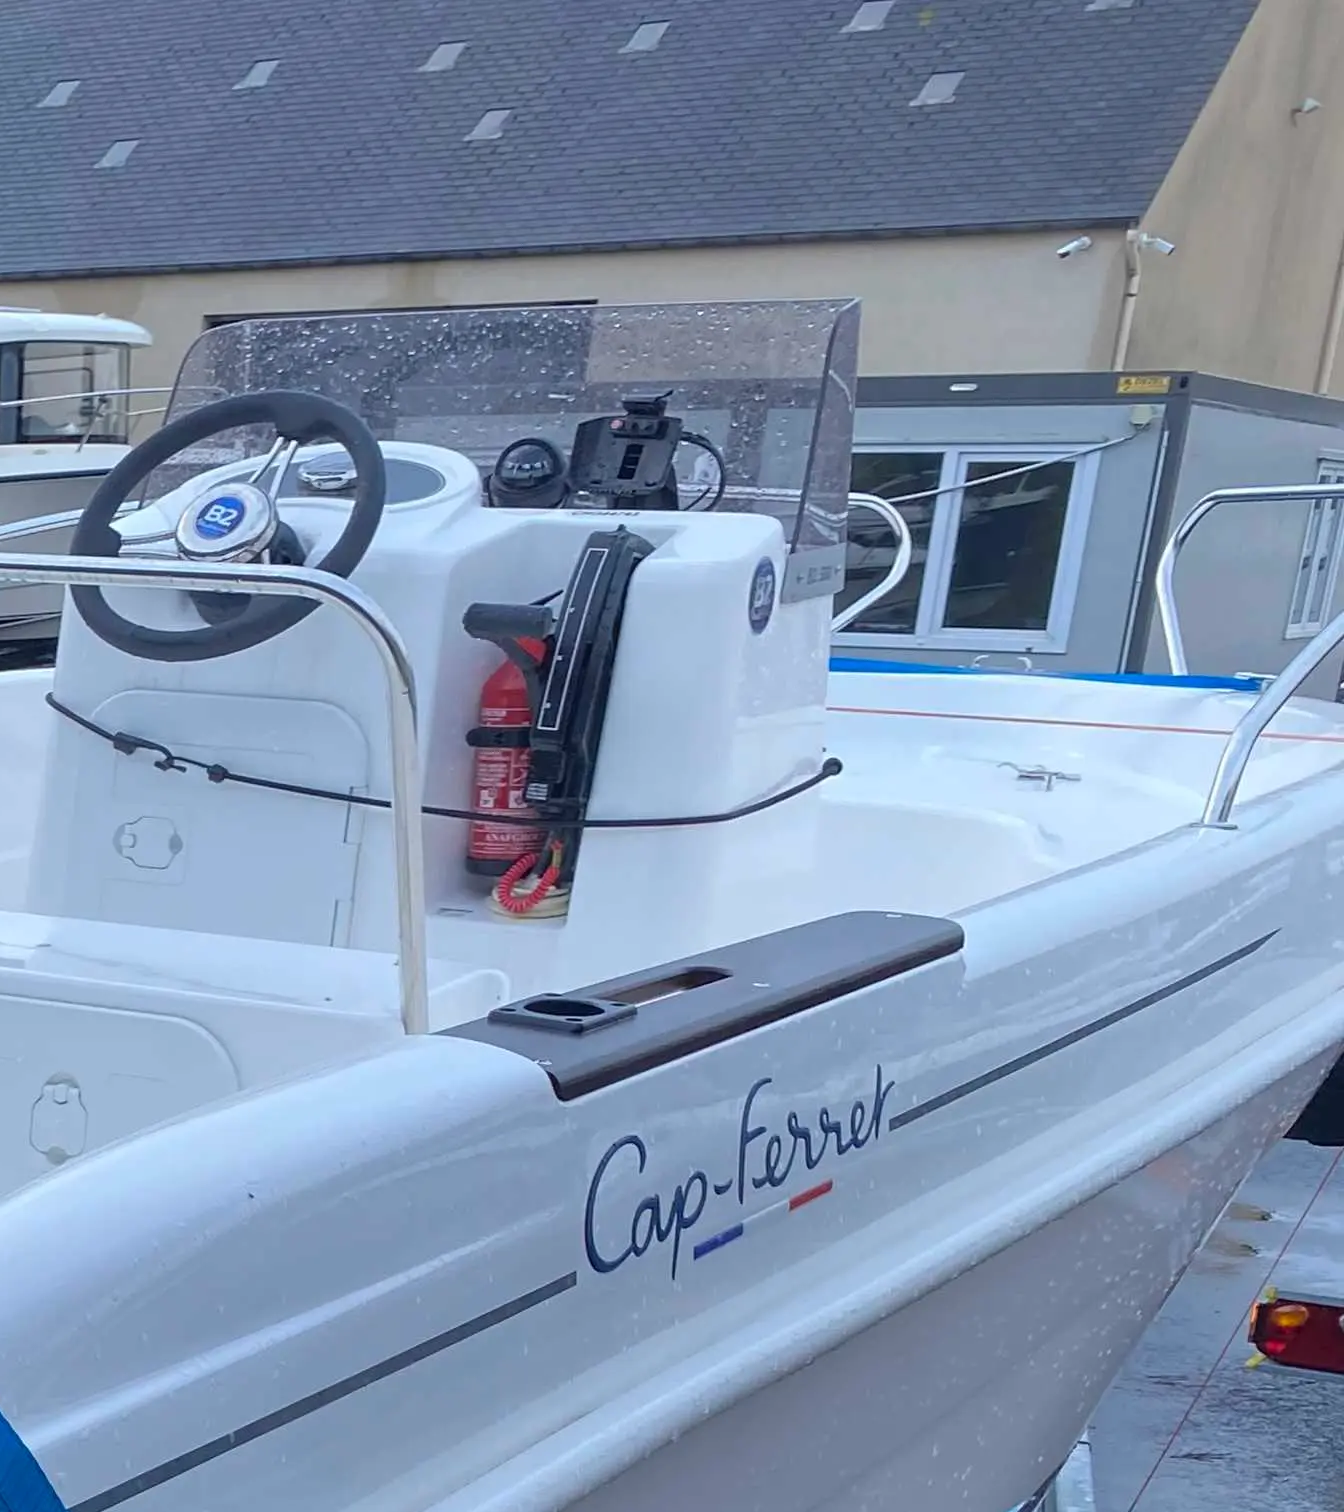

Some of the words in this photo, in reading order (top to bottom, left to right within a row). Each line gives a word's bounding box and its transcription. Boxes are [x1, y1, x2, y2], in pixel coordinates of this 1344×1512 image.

[204, 504, 238, 526] B2
[753, 573, 773, 608] B2
[584, 1063, 896, 1281] Cap-Ferret
